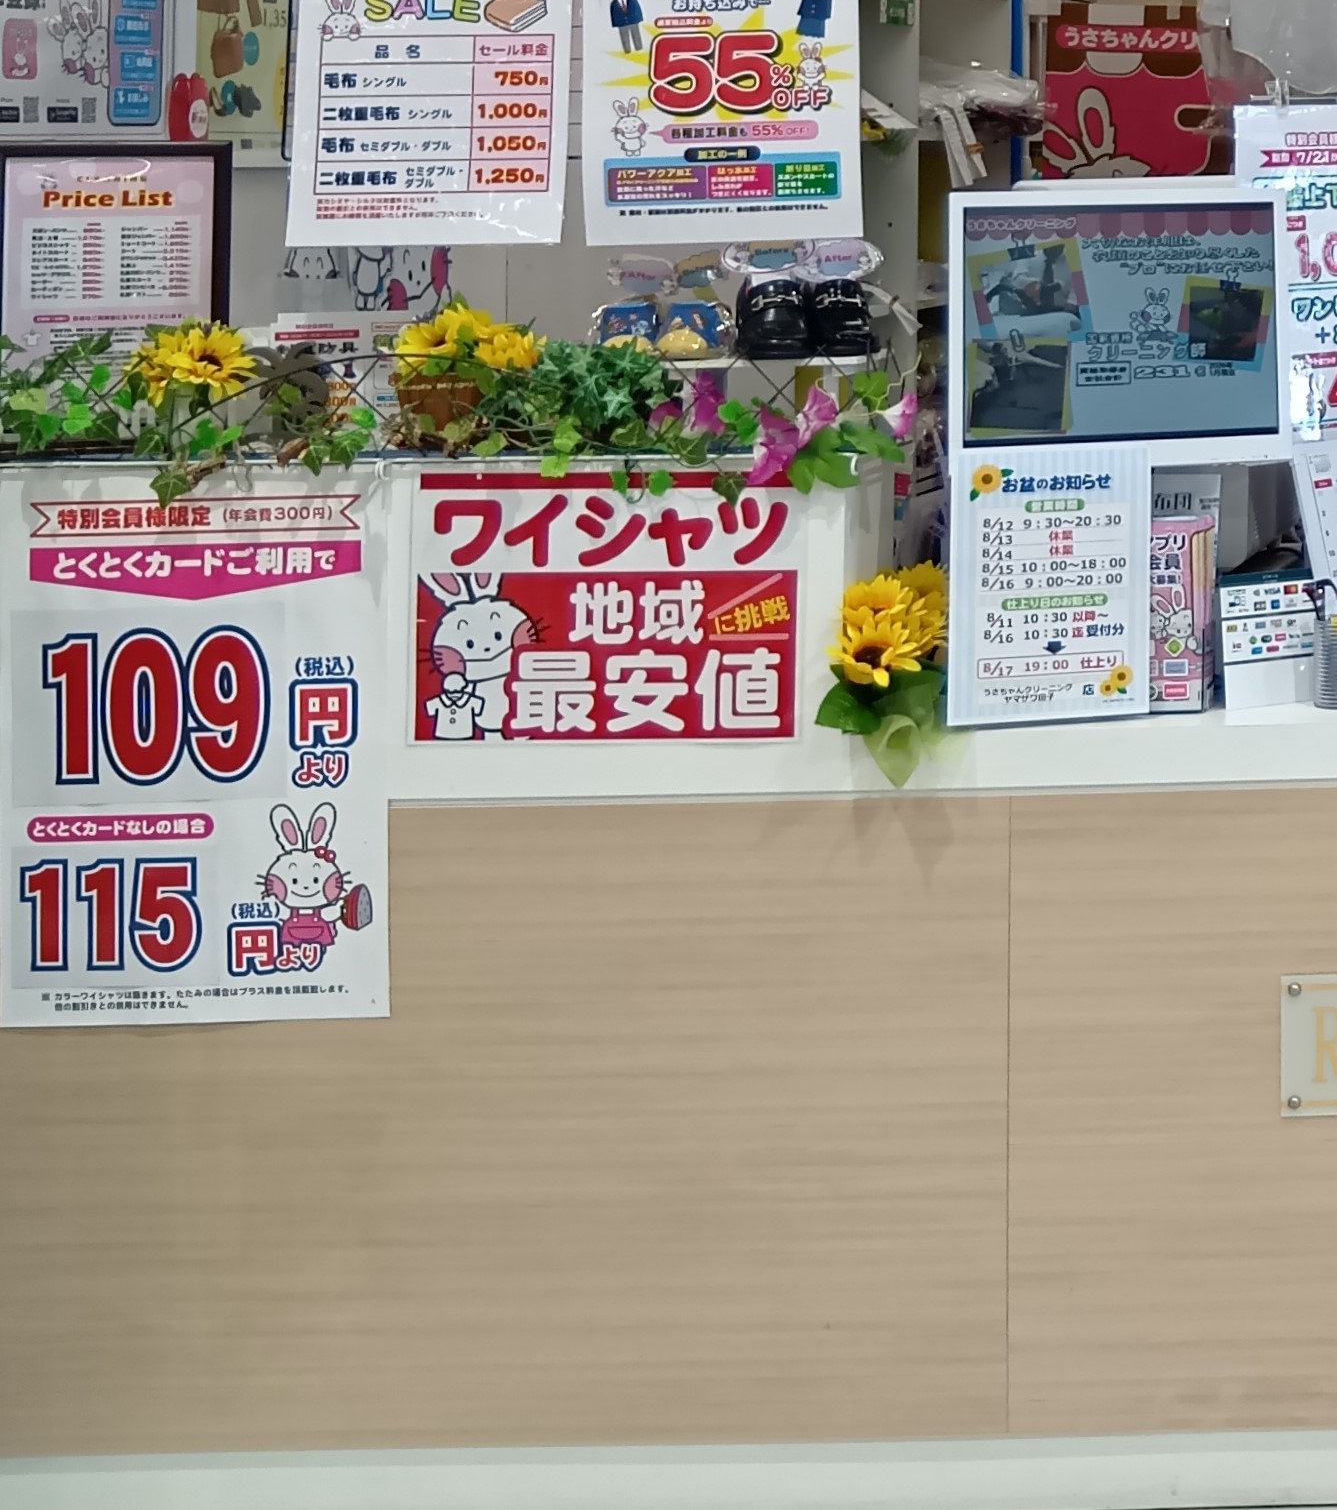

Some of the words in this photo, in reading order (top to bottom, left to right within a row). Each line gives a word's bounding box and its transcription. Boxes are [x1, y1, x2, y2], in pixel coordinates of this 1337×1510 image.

[479, 42, 549, 56] セール料金
[324, 73, 357, 88] 毛布
[362, 77, 407, 87] シングル
[494, 70, 549, 87] 750円
[650, 31, 783, 115] 55
[771, 88, 829, 110] OFF
[322, 106, 400, 122] 二枚重毛布
[408, 109, 452, 119] シングル
[477, 103, 548, 119] 1,000円
[752, 125, 783, 137] 55%
[321, 137, 355, 153] 毛布
[359, 141, 452, 152] セミダブル・ダブル
[476, 136, 547, 152] 1,050円
[319, 170, 397, 186] 二枚重毛布
[475, 168, 545, 184] 1,250円
[404, 178, 435, 189] ダブル
[42, 191, 115, 208] Price
[122, 190, 173, 207] List
[824, 253, 852, 263] After
[1087, 343, 1207, 362] クリーニング師
[1134, 364, 1191, 379] 231
[1002, 473, 1112, 493] お盆のお知らせ
[1154, 492, 1192, 510] 布団
[58, 506, 211, 530] 特別会員様限定
[223, 504, 333, 523] (年会費300円)
[983, 518, 1013, 531] 8/12
[434, 493, 789, 567] ワイシャツ
[983, 532, 1013, 546] 8/13
[1048, 530, 1074, 542] 休業
[982, 547, 1013, 561] 8/14
[1049, 545, 1074, 557] 休業
[53, 546, 336, 580] とくとくカードご利用で
[982, 562, 1014, 575] 8/15
[1150, 554, 1182, 571] 会員
[981, 577, 1014, 590] 8/16
[1006, 595, 1105, 610] 仕上り日のお知らせ
[569, 579, 706, 645] 地域
[714, 595, 791, 635] に挑戦
[986, 613, 1014, 628] 8/11
[1023, 611, 1068, 624] 10:30
[983, 629, 1014, 644] 8/16
[1023, 627, 1069, 640] 10:30
[1086, 625, 1125, 638] 受付分
[295, 656, 355, 677] (税込)
[983, 662, 1013, 677] 8/17
[1024, 659, 1069, 672] 19:00
[1080, 655, 1118, 669] 仕上り
[509, 647, 782, 734] 最安値
[984, 683, 1073, 697] うさちゃんクリーニング
[1082, 683, 1095, 696] 店
[42, 624, 271, 787] 109
[289, 678, 359, 752] 円
[291, 748, 349, 788] より
[32, 818, 207, 837] とくとくカードなしの場合
[20, 856, 203, 973] 115
[231, 902, 281, 920] (税込)
[227, 920, 282, 977] 円
[276, 943, 324, 972] より
